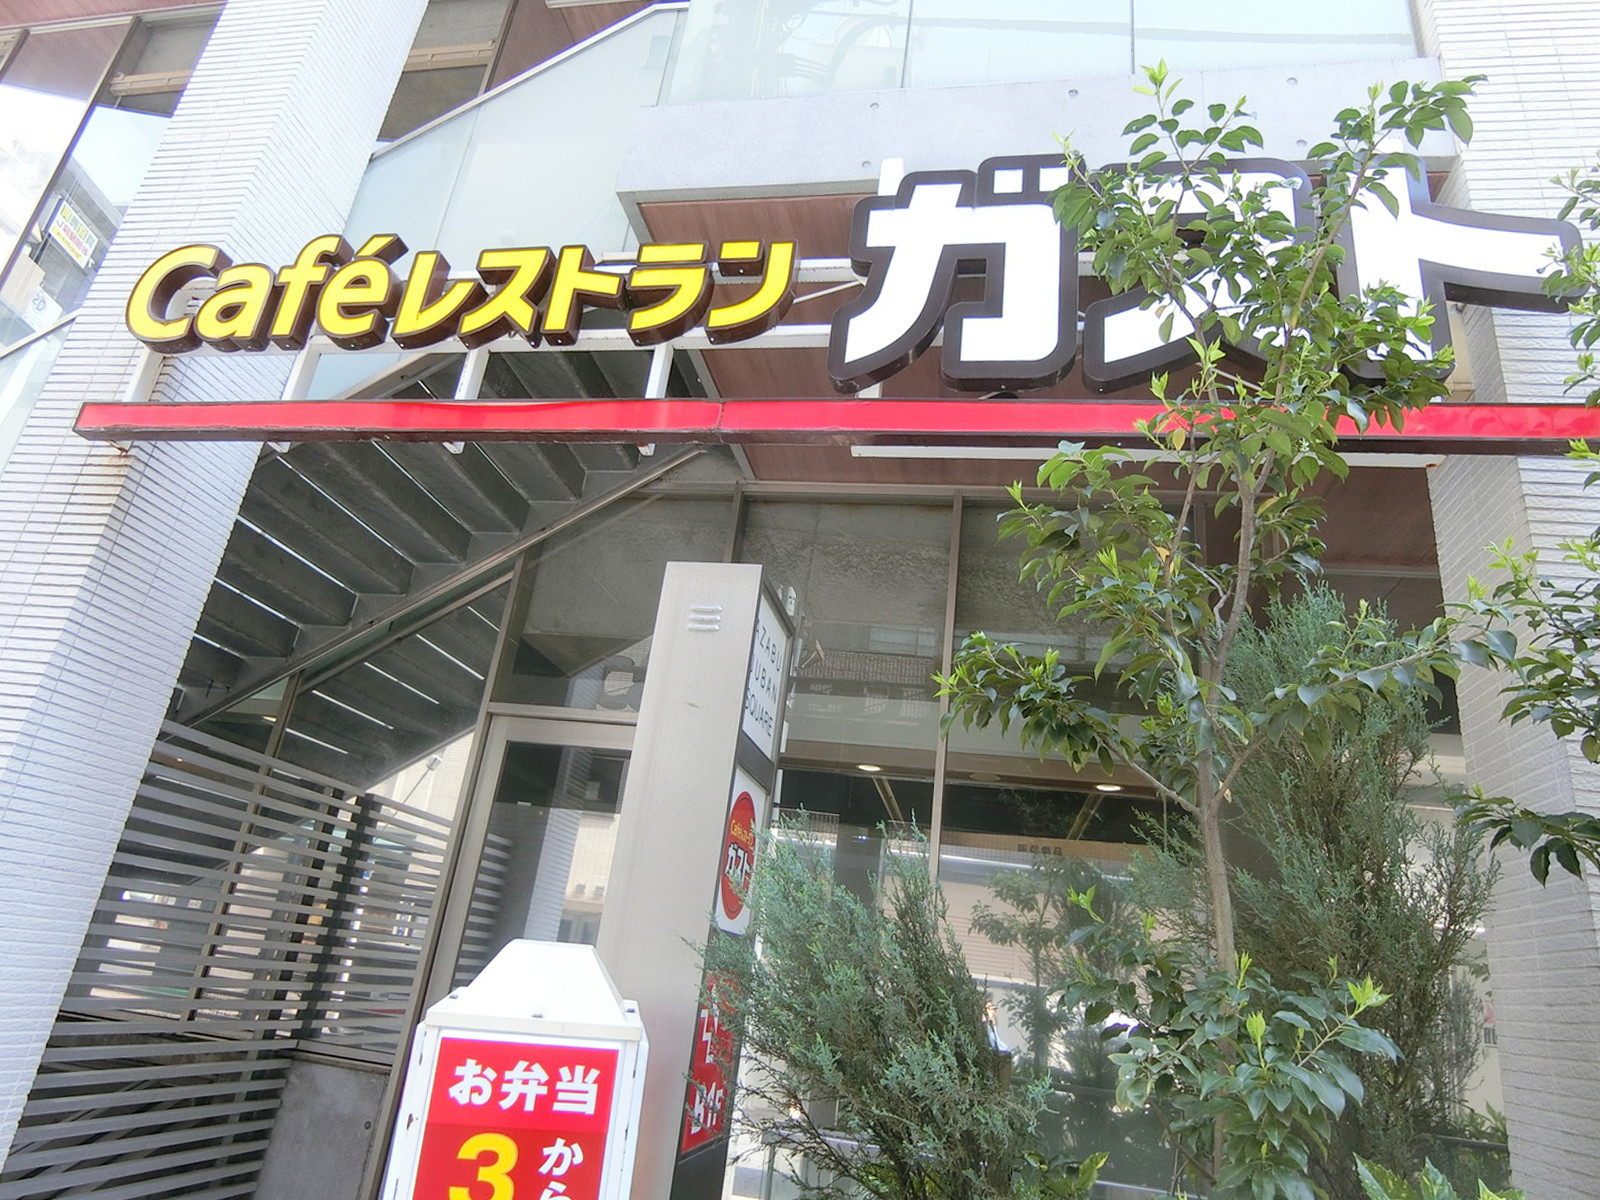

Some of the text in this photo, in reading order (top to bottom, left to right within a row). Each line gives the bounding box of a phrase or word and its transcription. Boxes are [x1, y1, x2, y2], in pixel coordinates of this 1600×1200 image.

[126, 234, 794, 352] Caféレストラン
[756, 618, 782, 673] AZABU
[743, 686, 774, 738] SQUARE
[448, 1058, 601, 1115] お弁当
[447, 1132, 519, 1200] 3
